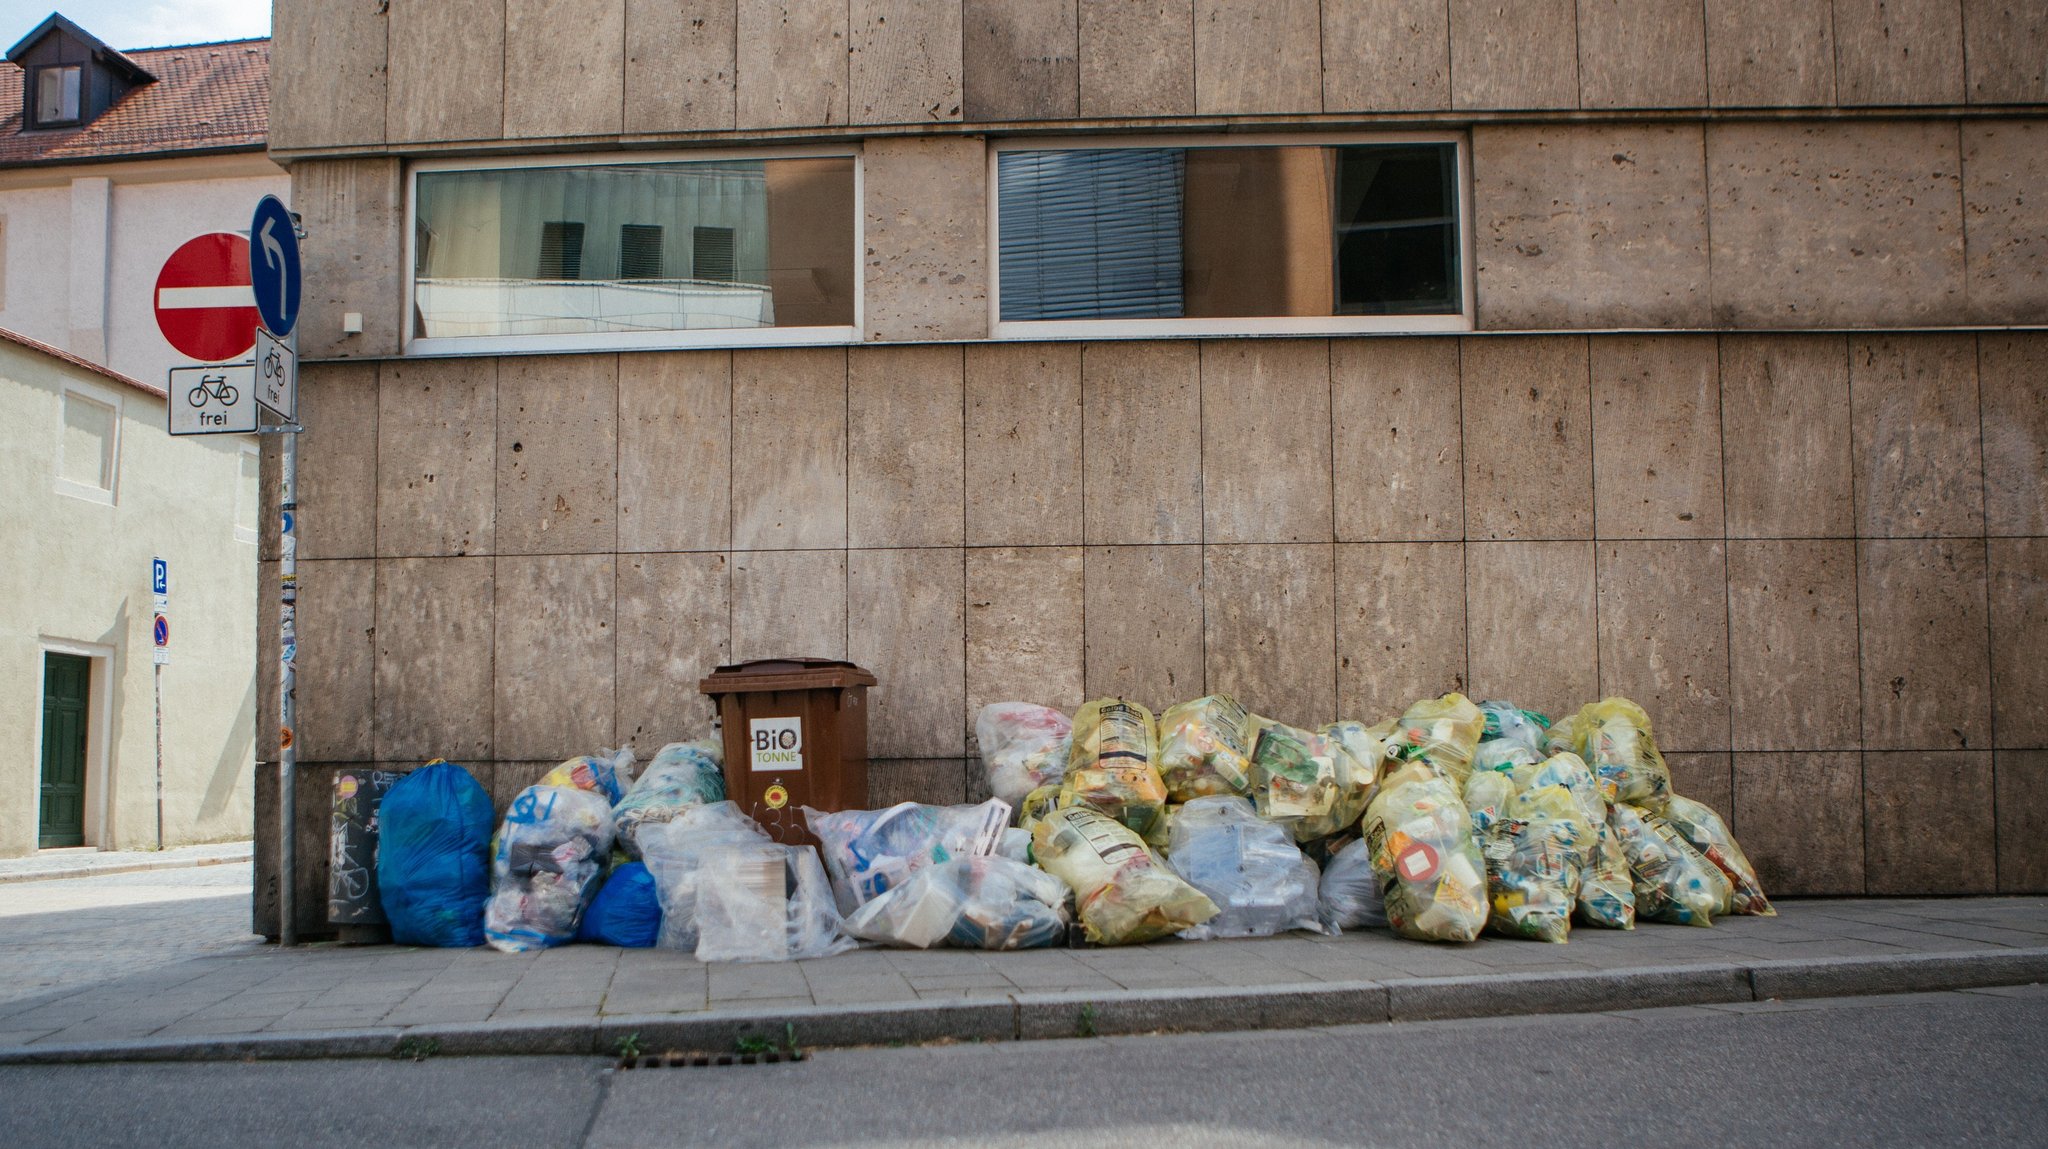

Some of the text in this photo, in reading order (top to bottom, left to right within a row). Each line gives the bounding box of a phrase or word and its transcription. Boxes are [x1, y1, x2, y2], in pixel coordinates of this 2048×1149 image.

[267, 384, 280, 404] frei
[200, 411, 227, 426] frei
[156, 563, 164, 589] P
[756, 751, 796, 763] TONNE
